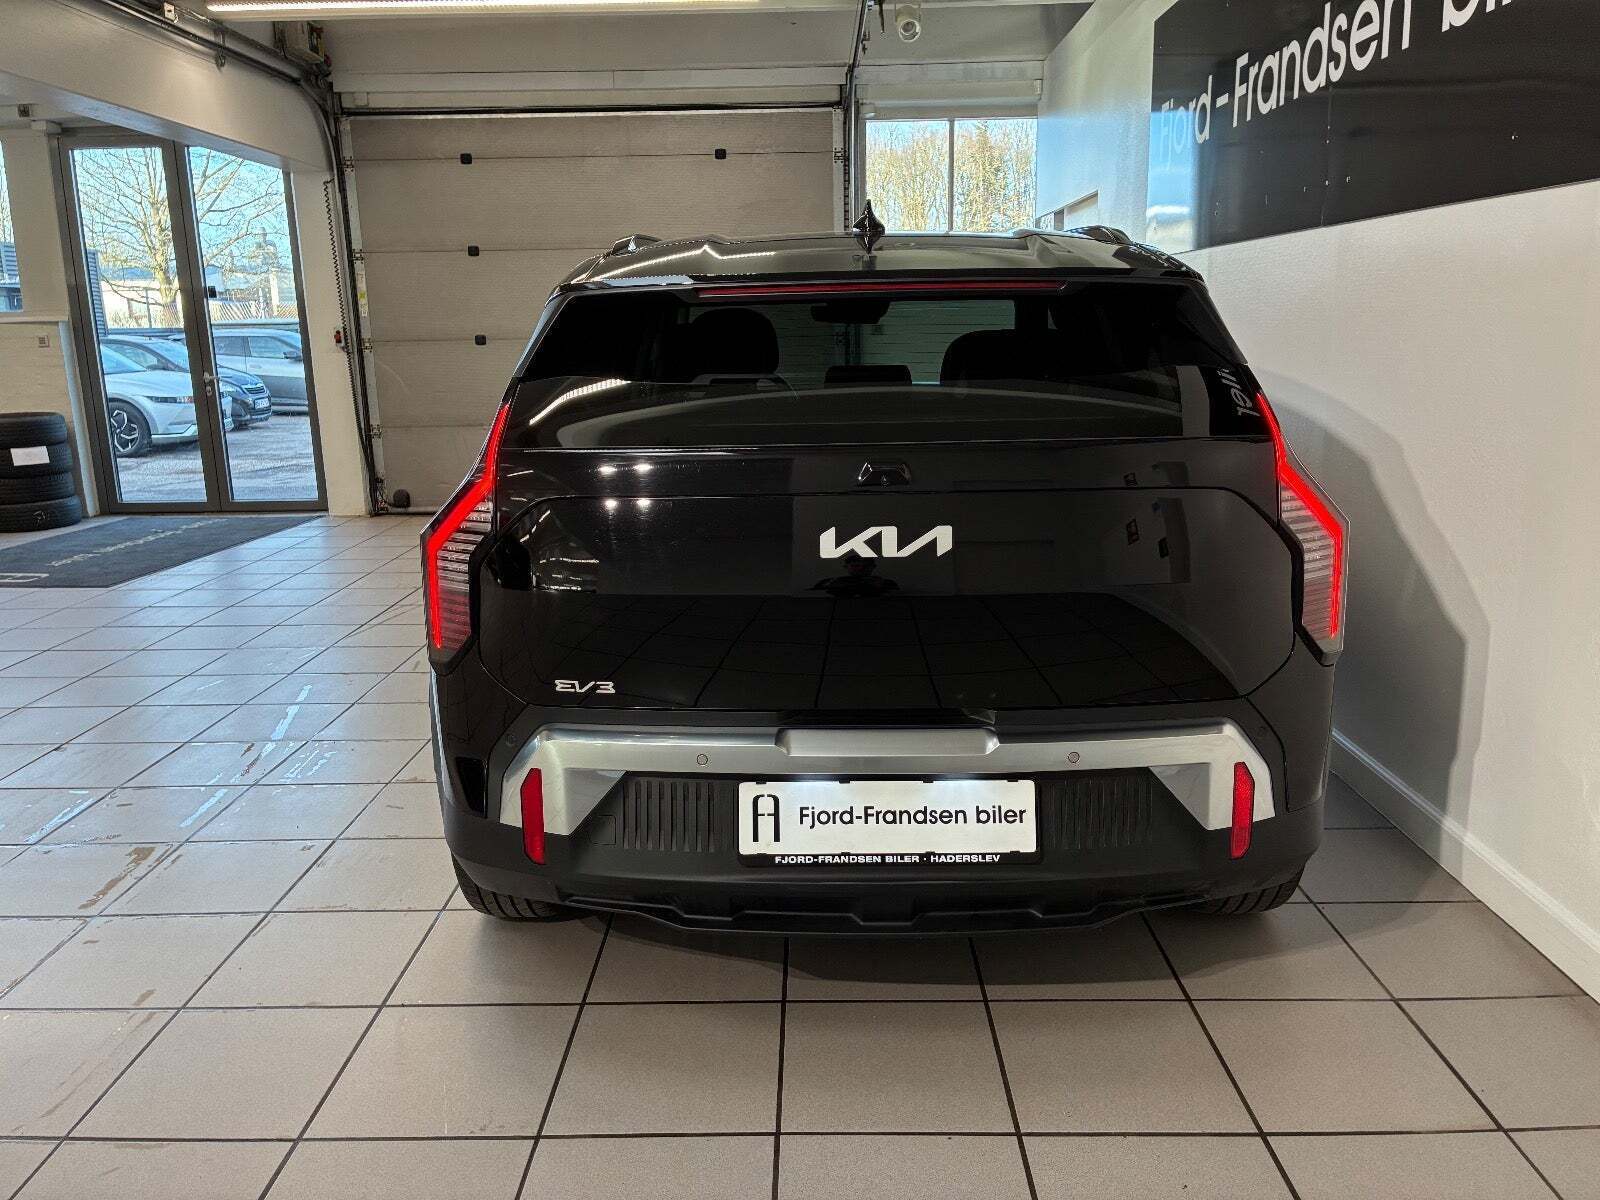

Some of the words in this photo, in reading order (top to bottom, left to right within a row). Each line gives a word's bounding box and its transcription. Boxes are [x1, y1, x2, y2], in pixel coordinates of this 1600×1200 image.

[820, 525, 953, 559] KIA
[554, 679, 616, 694] EV3
[799, 805, 968, 829] Fjord-Frandsen
[975, 805, 1027, 825] biler
[775, 855, 882, 864] FJORD-FRANDSEN
[885, 855, 920, 864] BILER
[930, 854, 1002, 864] HADERSLEV
